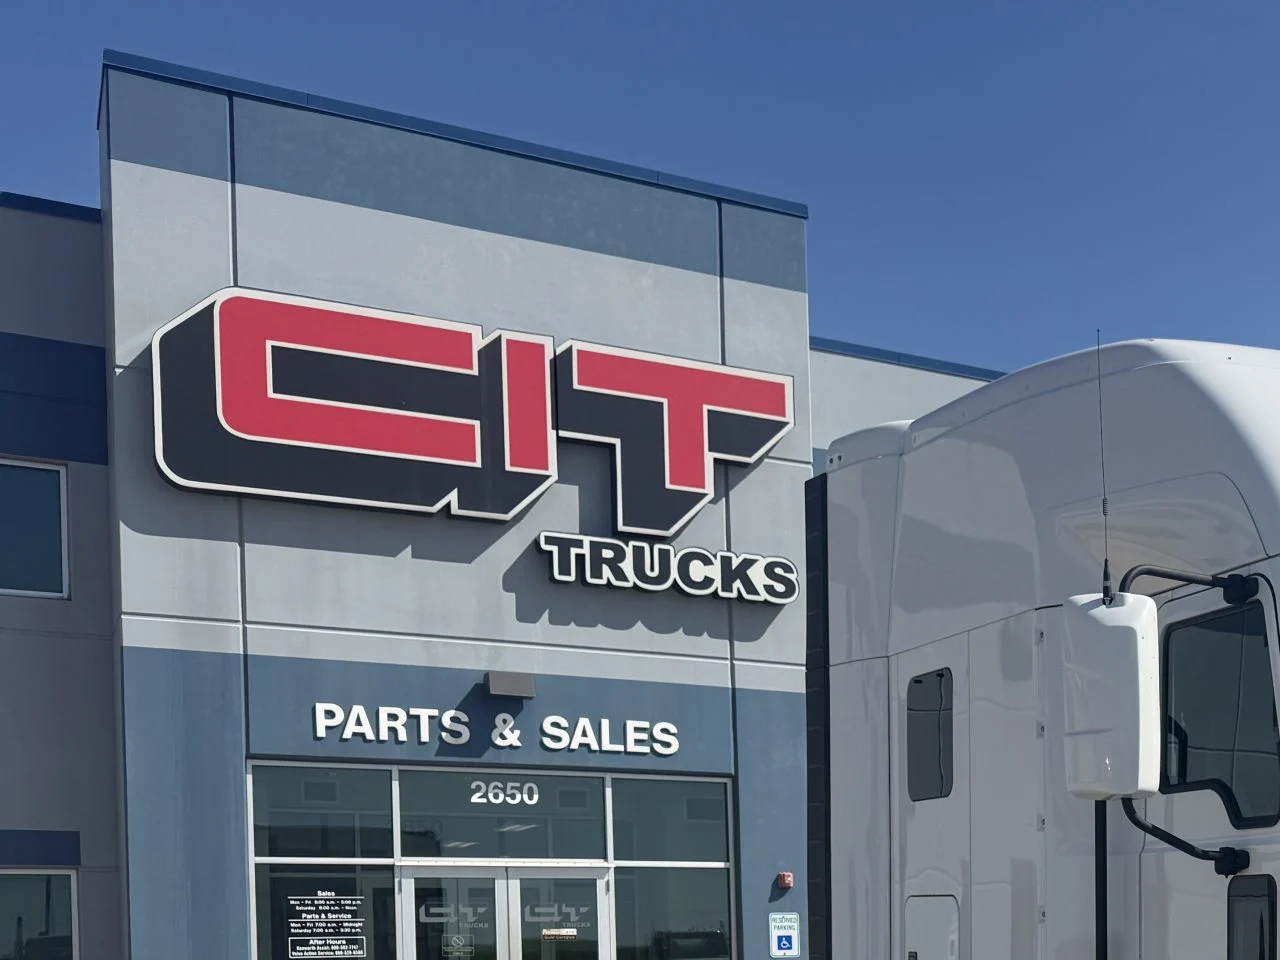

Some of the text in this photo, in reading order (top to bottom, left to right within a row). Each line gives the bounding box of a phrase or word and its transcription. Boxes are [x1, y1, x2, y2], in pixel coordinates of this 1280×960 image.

[152, 287, 794, 536] CIT
[540, 531, 800, 604] TRUCKS
[315, 702, 680, 755] PARTS & SALES
[470, 780, 540, 805] 2650
